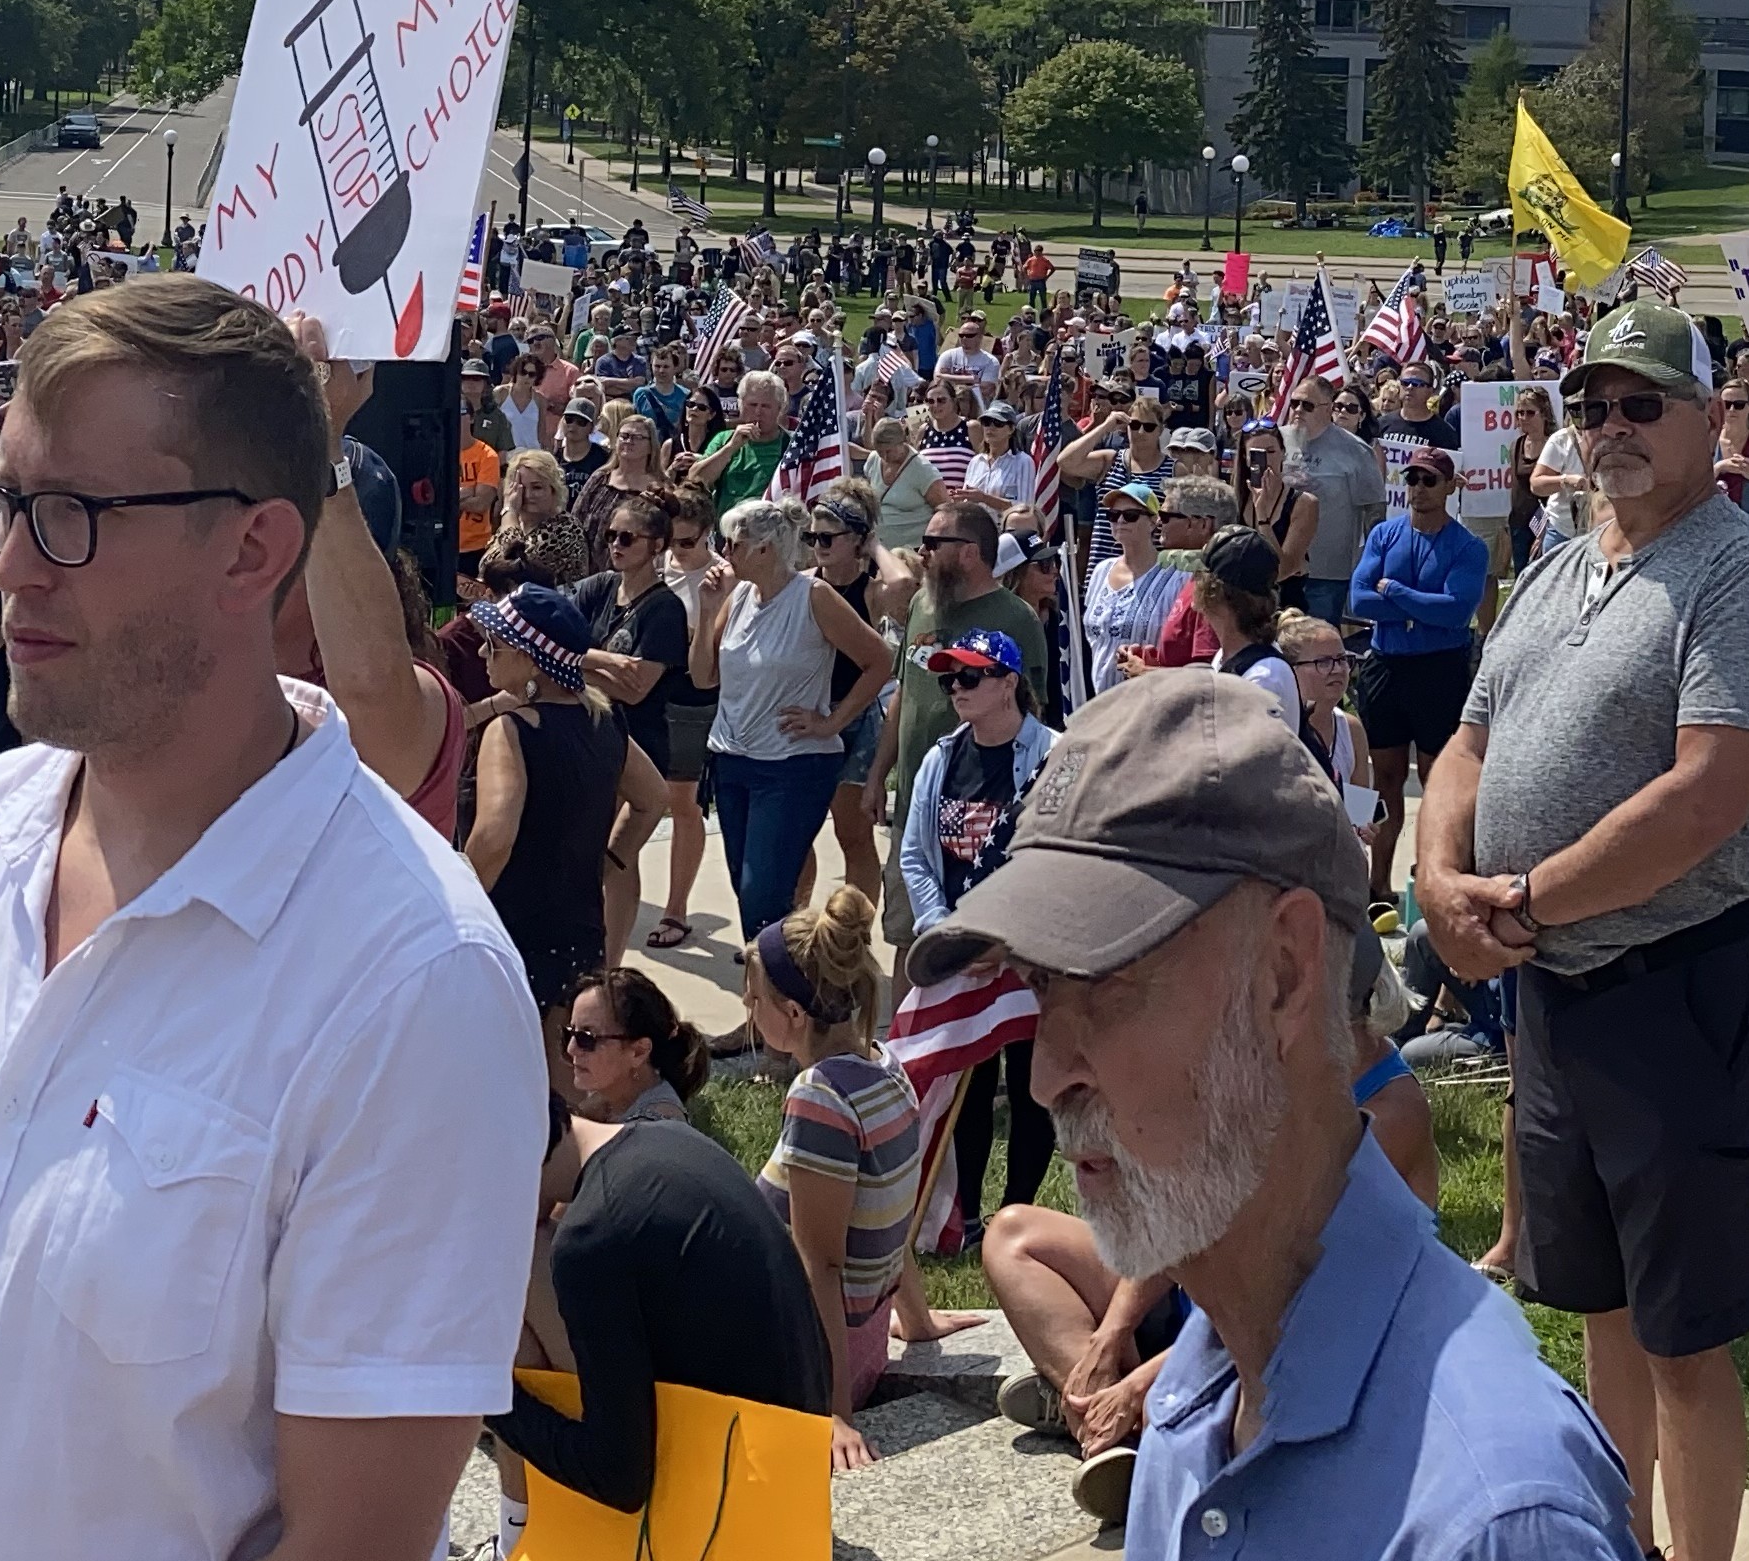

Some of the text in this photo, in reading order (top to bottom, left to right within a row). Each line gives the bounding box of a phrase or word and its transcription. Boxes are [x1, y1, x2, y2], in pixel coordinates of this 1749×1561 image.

[214, 142, 281, 251] MY
[317, 93, 380, 210] STOP
[1624, 342, 1646, 351] LAKE
